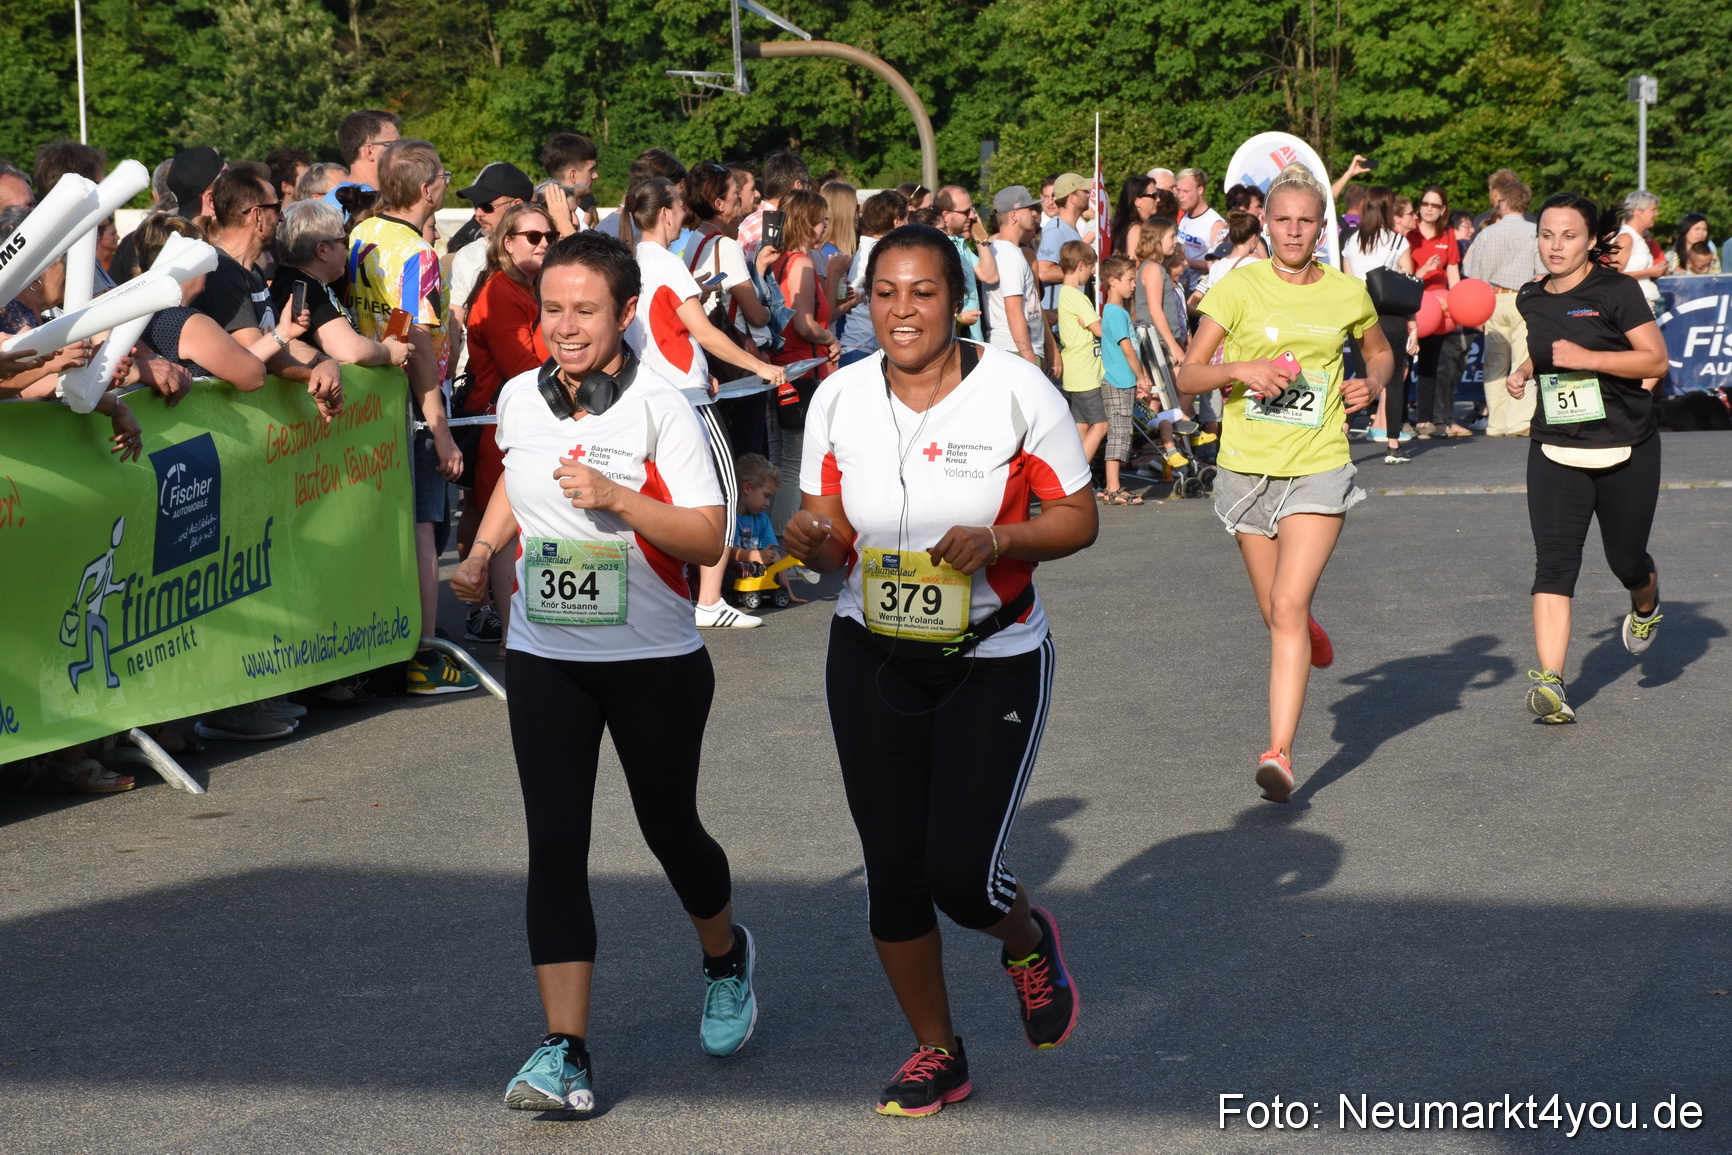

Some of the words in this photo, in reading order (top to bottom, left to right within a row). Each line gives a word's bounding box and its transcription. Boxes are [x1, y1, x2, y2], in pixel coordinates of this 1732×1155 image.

[1558, 391, 1578, 409] 51
[589, 451, 611, 460] Rotes
[946, 449, 968, 457] Rotes
[947, 442, 993, 451] Bayerisches
[294, 453, 343, 508] laufen
[344, 424, 400, 491] länger!
[587, 457, 610, 466] Kreuz
[945, 456, 967, 464] Kreuz
[943, 467, 985, 479] Yolanda
[169, 477, 212, 508] Fischer
[172, 498, 208, 519] AUTOMOBILE
[121, 516, 274, 645] firmenlauf
[540, 569, 600, 601] 364
[541, 600, 559, 609] Knör
[561, 602, 598, 610] Susanne
[880, 581, 942, 616] 379
[879, 612, 907, 622] Werner
[909, 616, 944, 625] Yolanda
[127, 624, 198, 676] neumarkt
[242, 605, 411, 679] www.firmenlauf-oberpfalz.de
